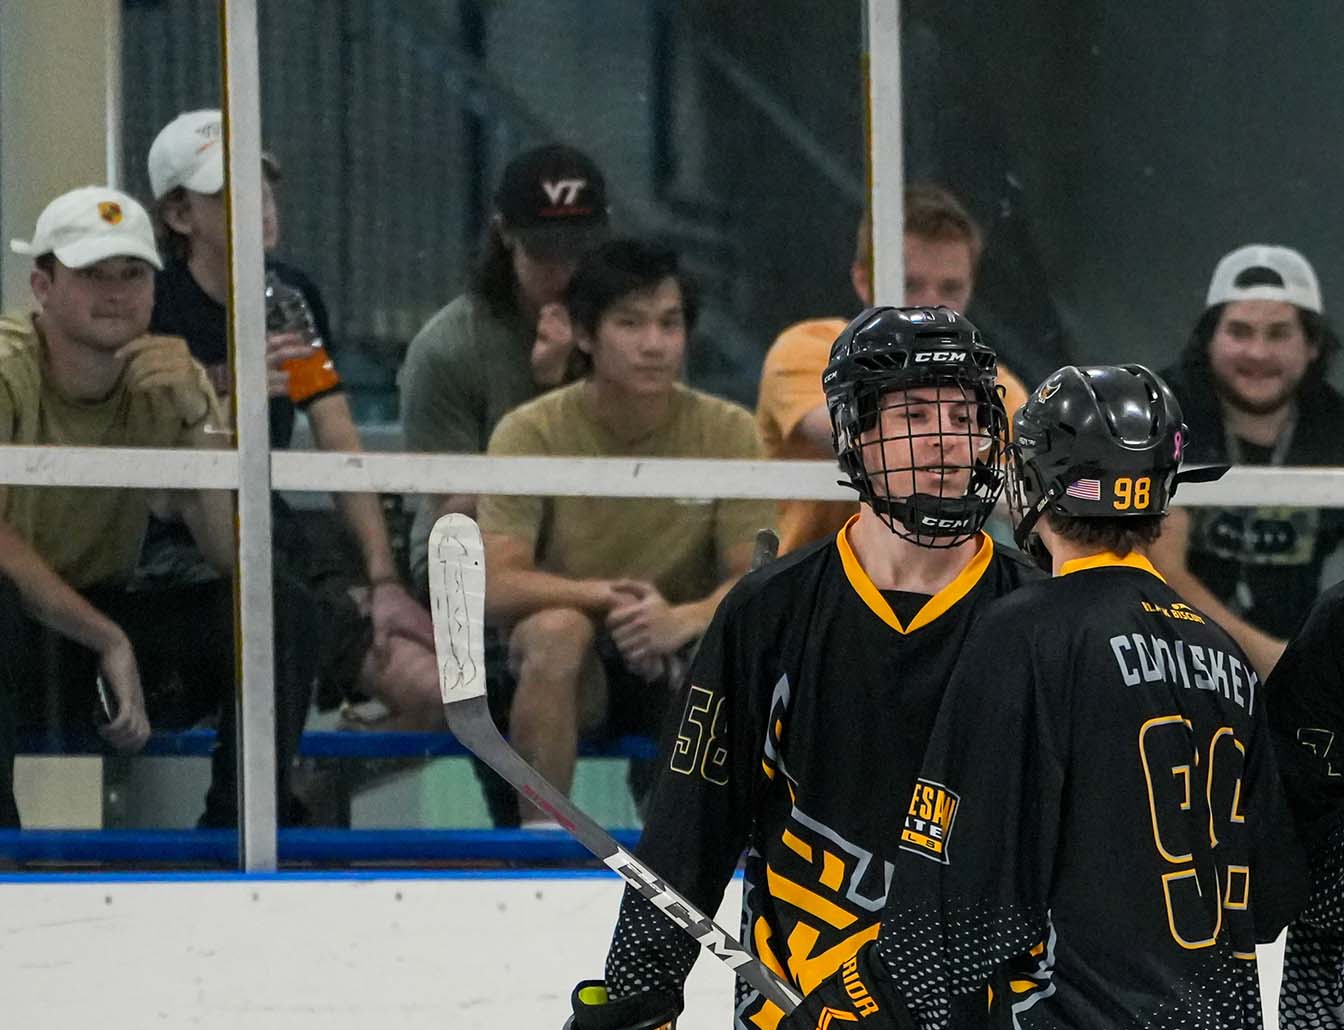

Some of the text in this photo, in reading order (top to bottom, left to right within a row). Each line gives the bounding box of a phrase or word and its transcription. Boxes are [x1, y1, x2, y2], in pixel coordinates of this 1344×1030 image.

[542, 180, 587, 206] VT
[914, 351, 967, 363] CCM
[1113, 476, 1151, 511] 98
[921, 516, 969, 529] CCM
[603, 846, 753, 970] CCM
